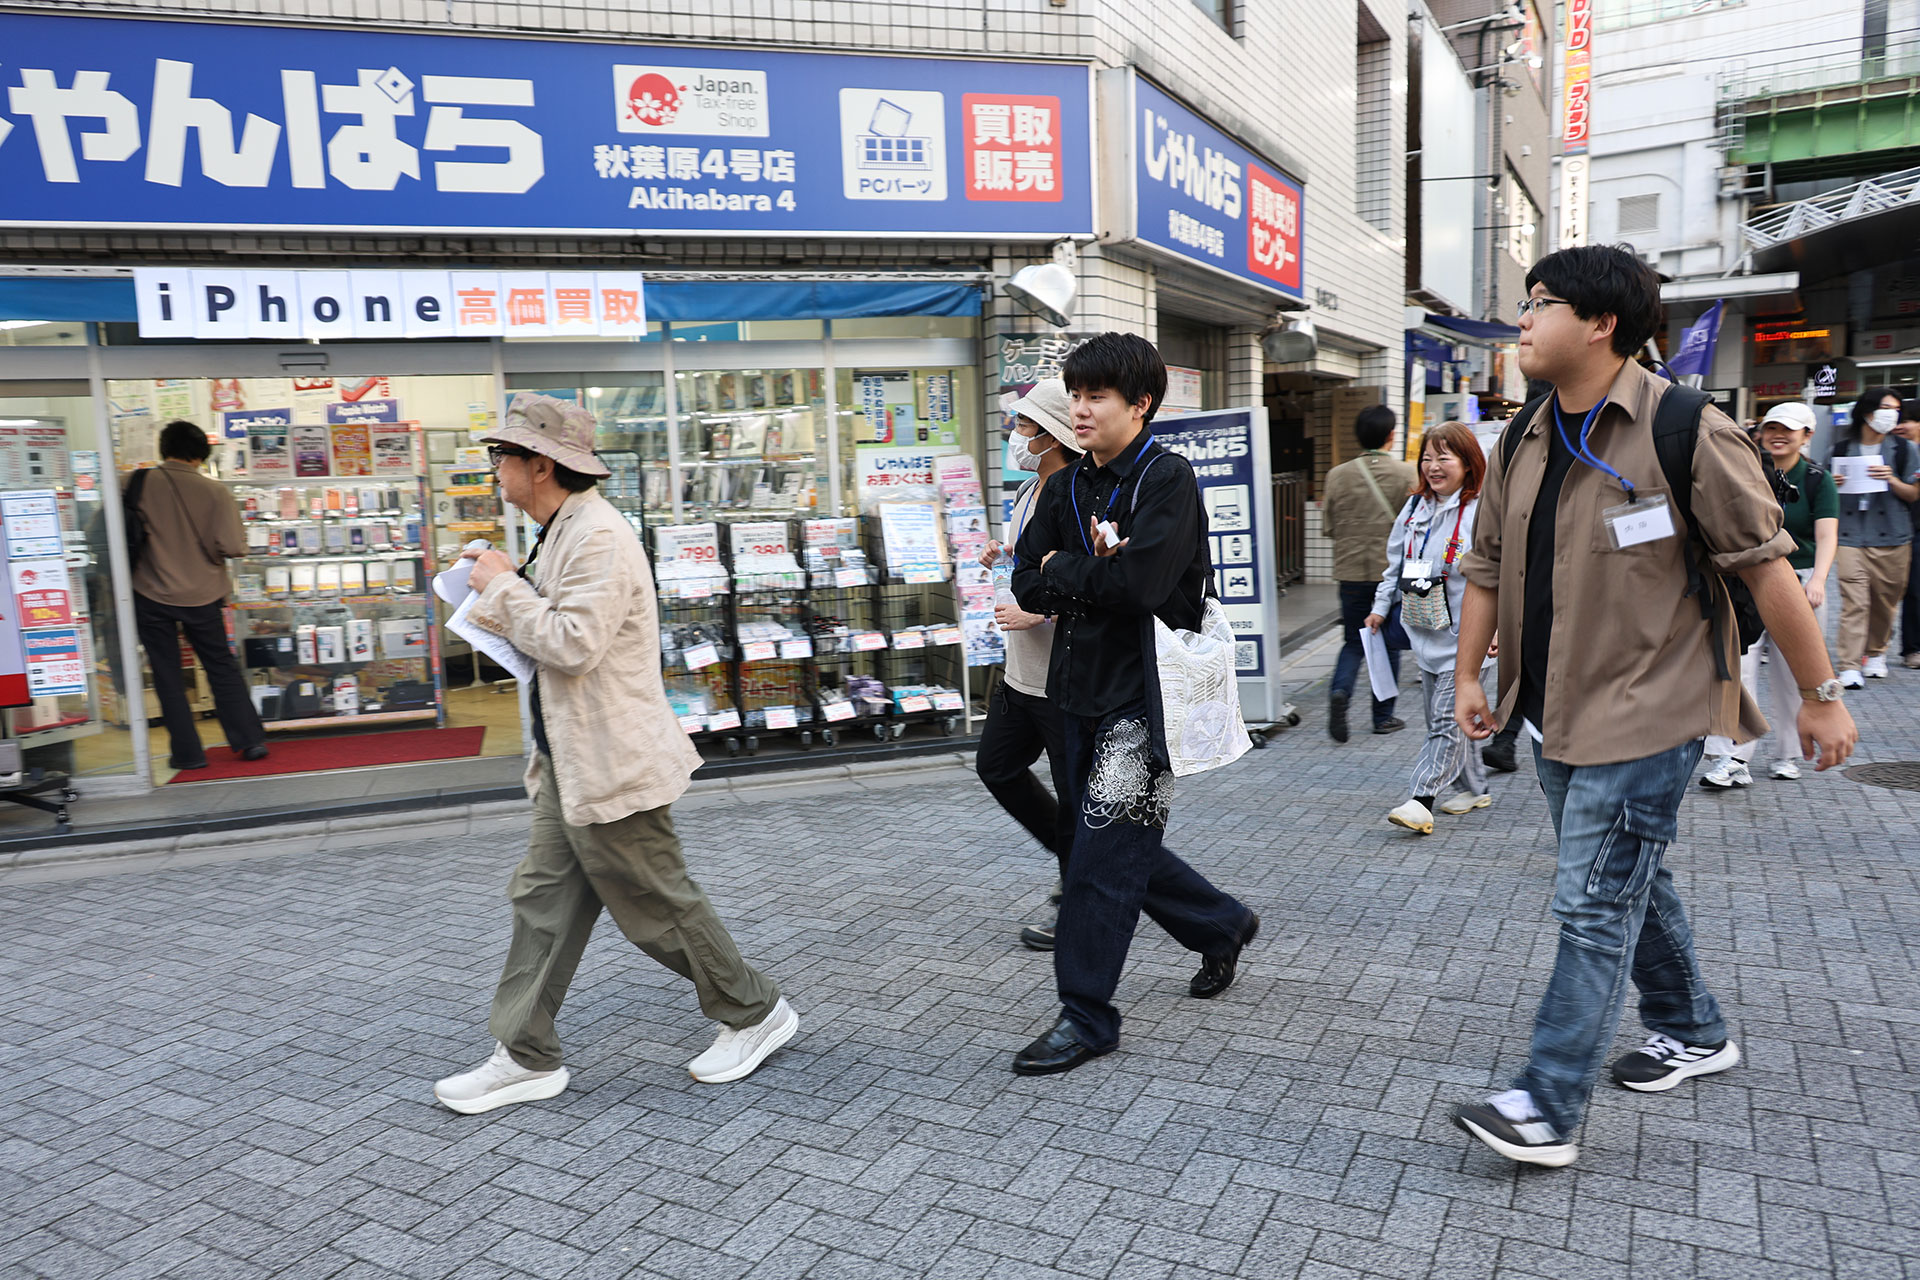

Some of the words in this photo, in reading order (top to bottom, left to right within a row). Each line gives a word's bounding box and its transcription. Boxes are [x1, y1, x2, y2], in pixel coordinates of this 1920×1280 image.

[693, 74, 758, 95] Japan.
[694, 94, 757, 111] Tax-free
[0, 58, 545, 193] ゃんぱら
[717, 112, 758, 129] Shop
[972, 104, 1053, 145] 買取
[593, 144, 796, 183] 秋葉原4号店
[973, 150, 1055, 192] 販売
[1144, 108, 1241, 219] じゃんぱら
[628, 187, 772, 212] Akihabara
[776, 188, 796, 212] 4
[859, 177, 932, 195] PCパーツ
[1251, 178, 1297, 237] 買取受付
[1168, 209, 1225, 258] 秋葉原4号店
[1252, 222, 1296, 270] センター
[158, 282, 442, 324] iPhone
[457, 286, 641, 326] 高価買取
